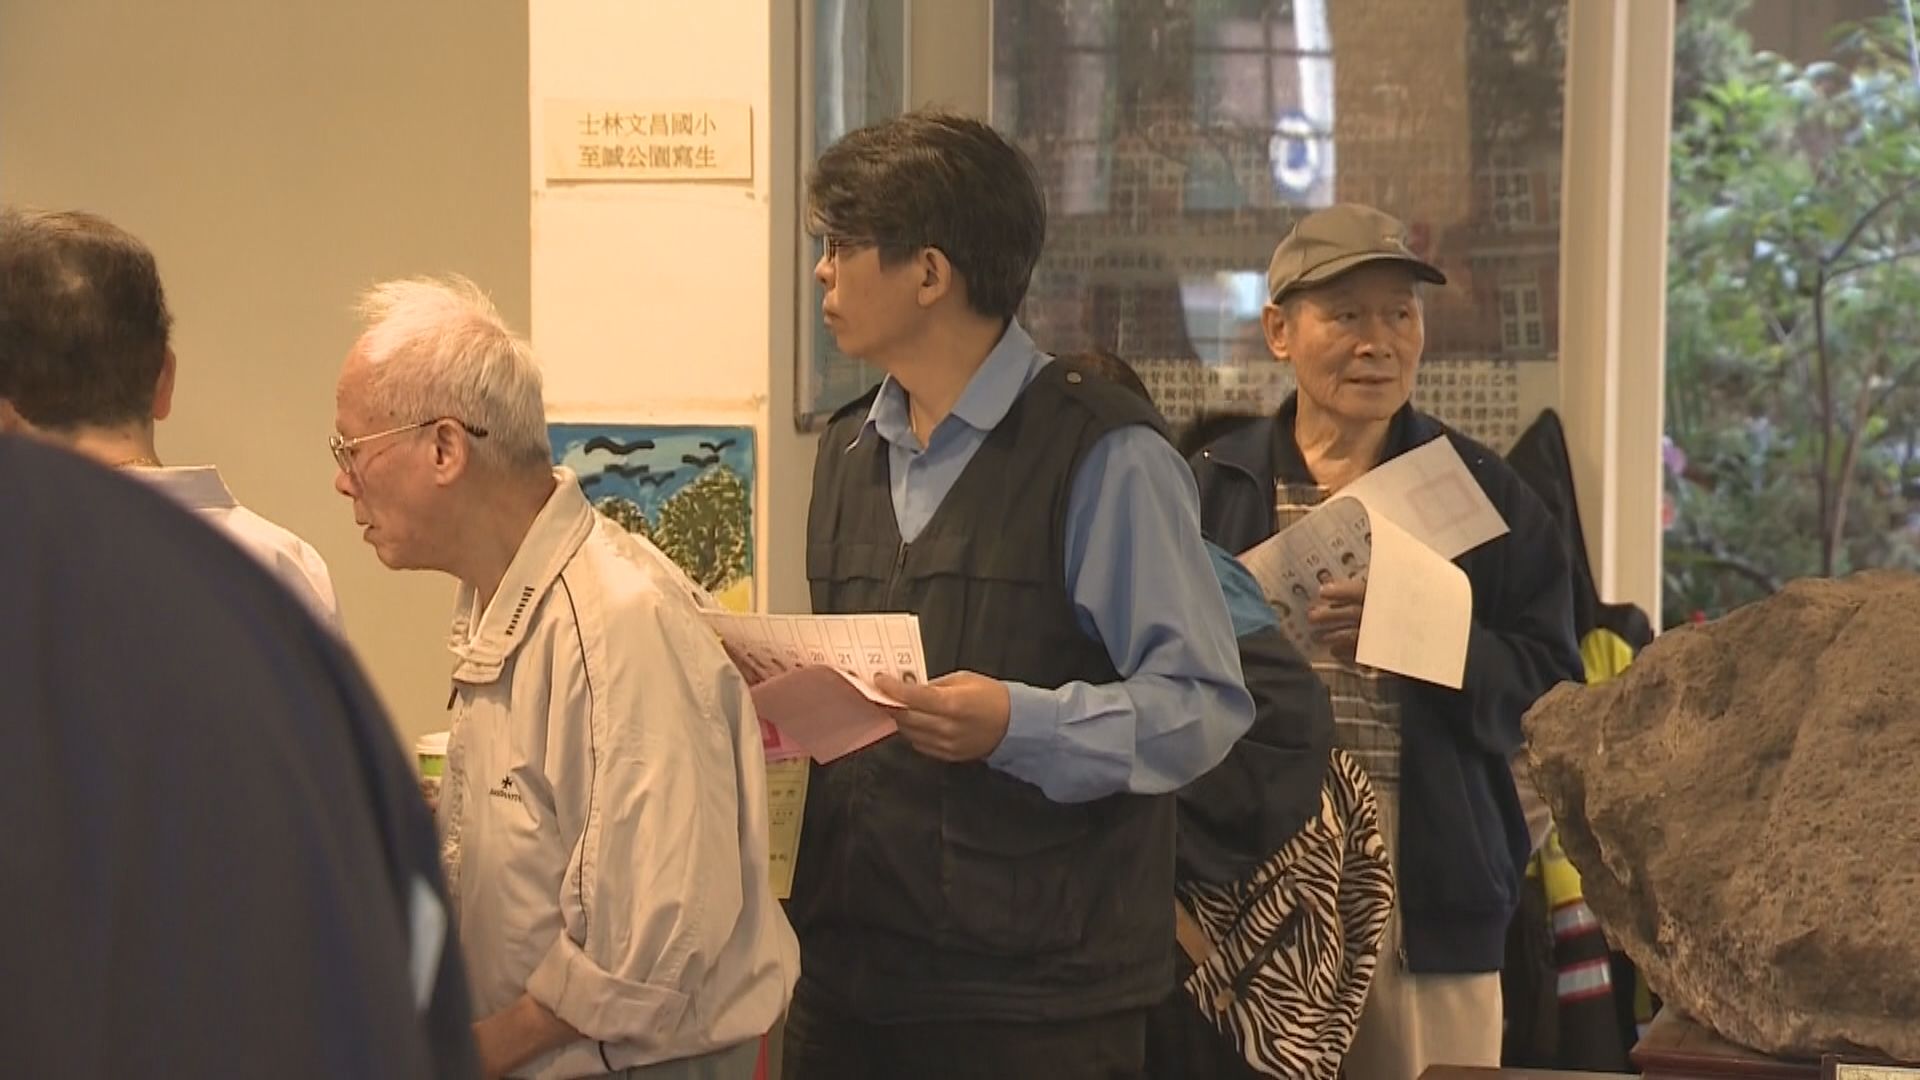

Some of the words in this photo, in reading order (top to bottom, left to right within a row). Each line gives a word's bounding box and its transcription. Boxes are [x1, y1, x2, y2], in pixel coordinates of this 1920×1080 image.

[577, 112, 717, 136] 士林文昌國小
[838, 653, 852, 664] 21
[867, 653, 883, 664] 22
[897, 652, 912, 664] 23
